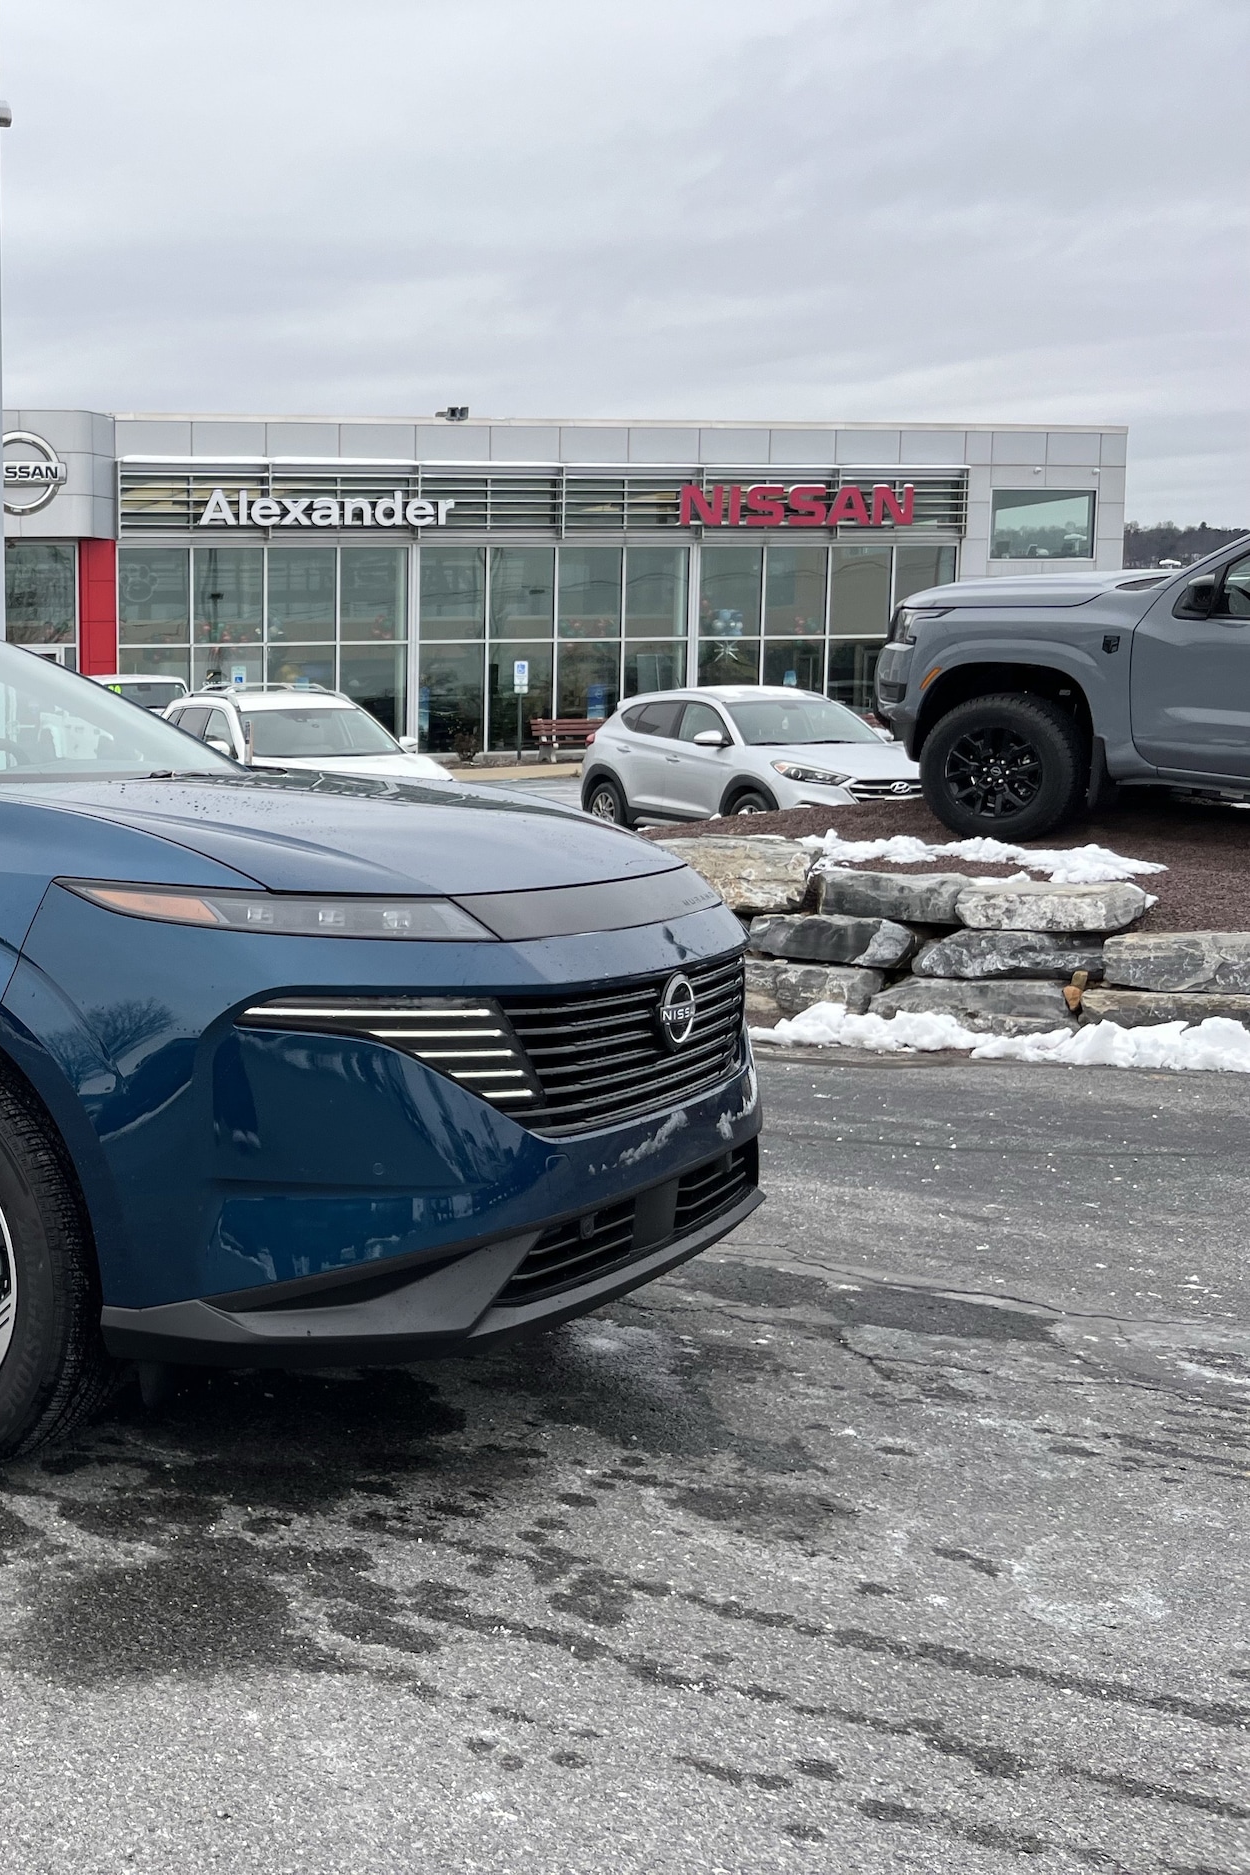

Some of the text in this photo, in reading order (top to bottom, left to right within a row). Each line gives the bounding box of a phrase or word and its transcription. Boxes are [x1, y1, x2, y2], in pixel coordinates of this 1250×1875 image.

[3, 465, 59, 480] SSAN
[198, 488, 455, 527] Alexander
[679, 484, 915, 527] NISSAN
[662, 1007, 691, 1021] NISS
